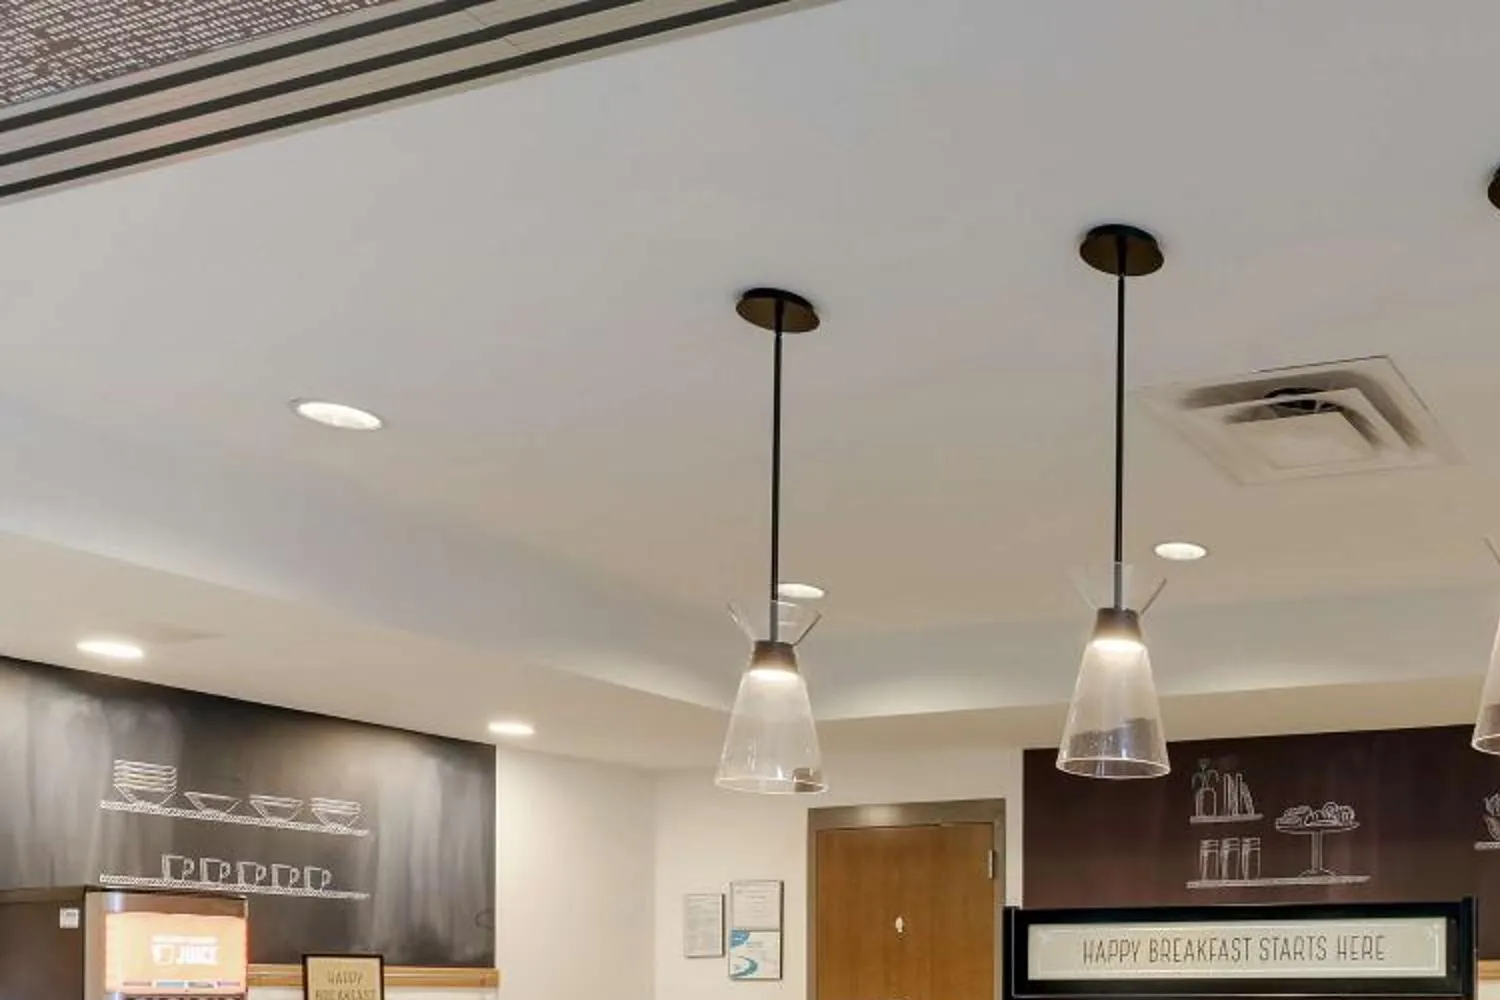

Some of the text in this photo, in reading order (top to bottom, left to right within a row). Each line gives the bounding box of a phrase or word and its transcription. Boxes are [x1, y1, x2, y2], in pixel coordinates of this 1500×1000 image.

[1082, 934, 1386, 964] HAPPY BREAKFAST STARTS HERE
[327, 968, 363, 985] HAPPY
